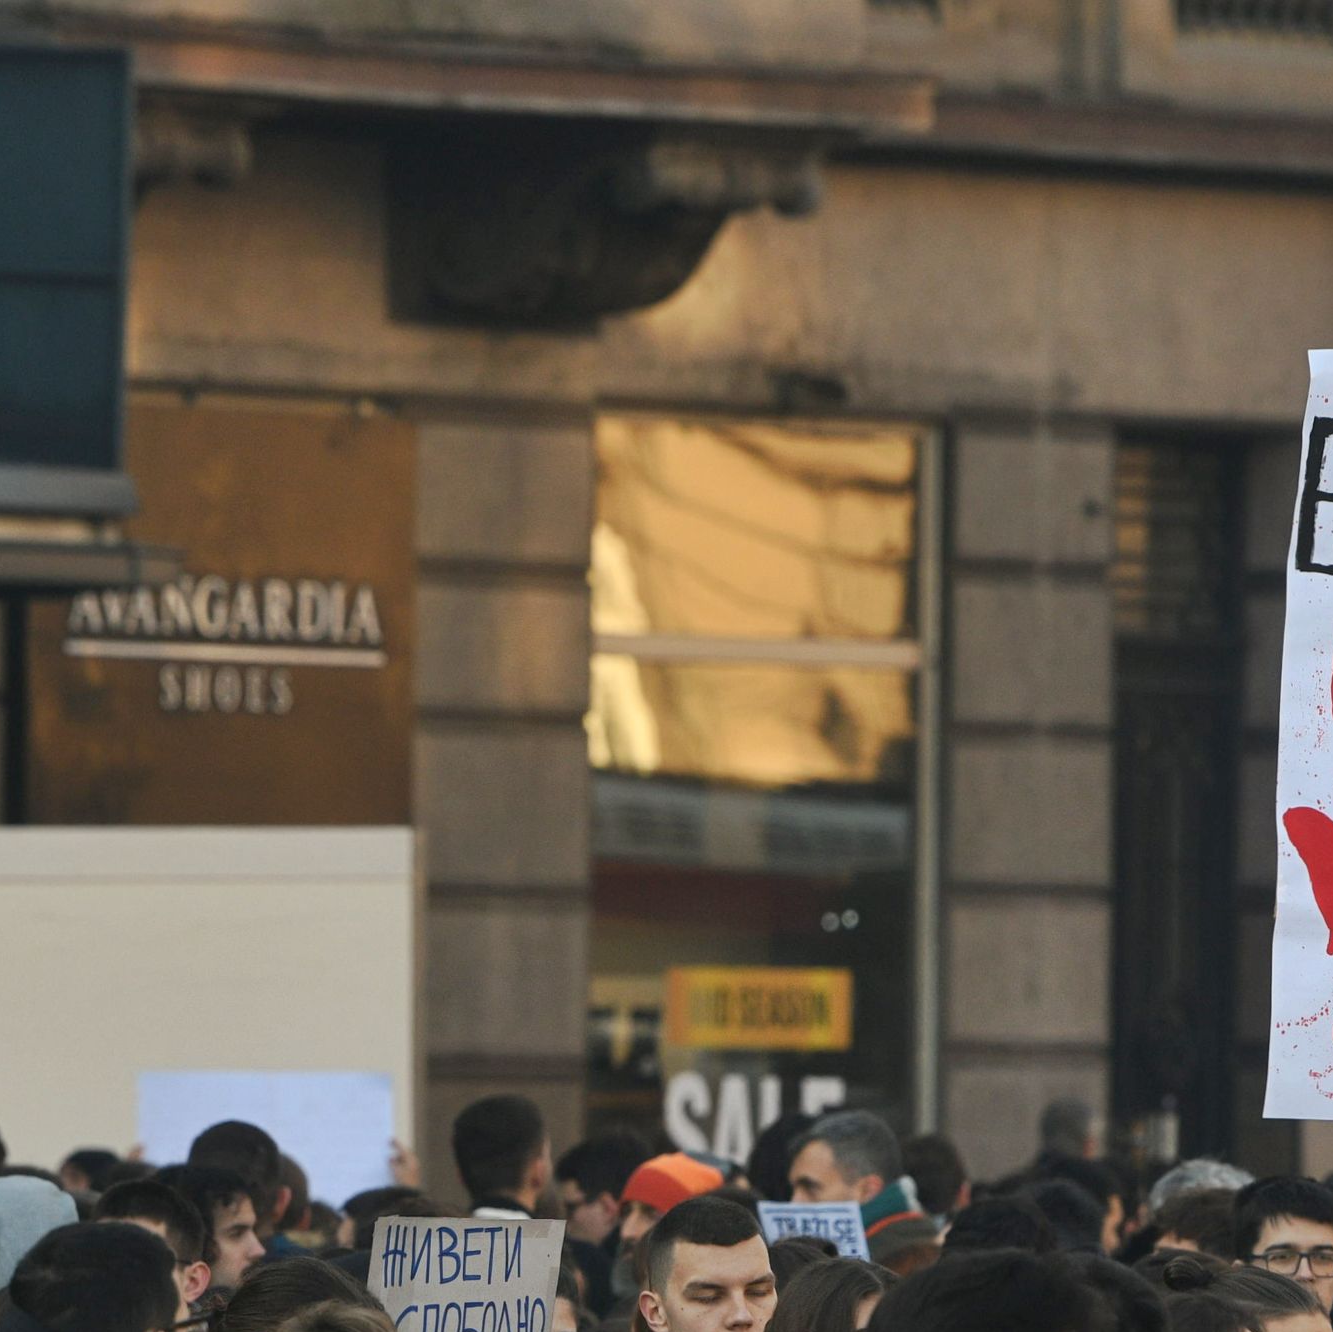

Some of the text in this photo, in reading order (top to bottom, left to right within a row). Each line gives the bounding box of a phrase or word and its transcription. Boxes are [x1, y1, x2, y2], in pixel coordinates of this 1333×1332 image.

[69, 575, 383, 644] AVANGARDIA
[159, 664, 293, 714] SHOES
[382, 1224, 523, 1288] ЖИВЕТИ
